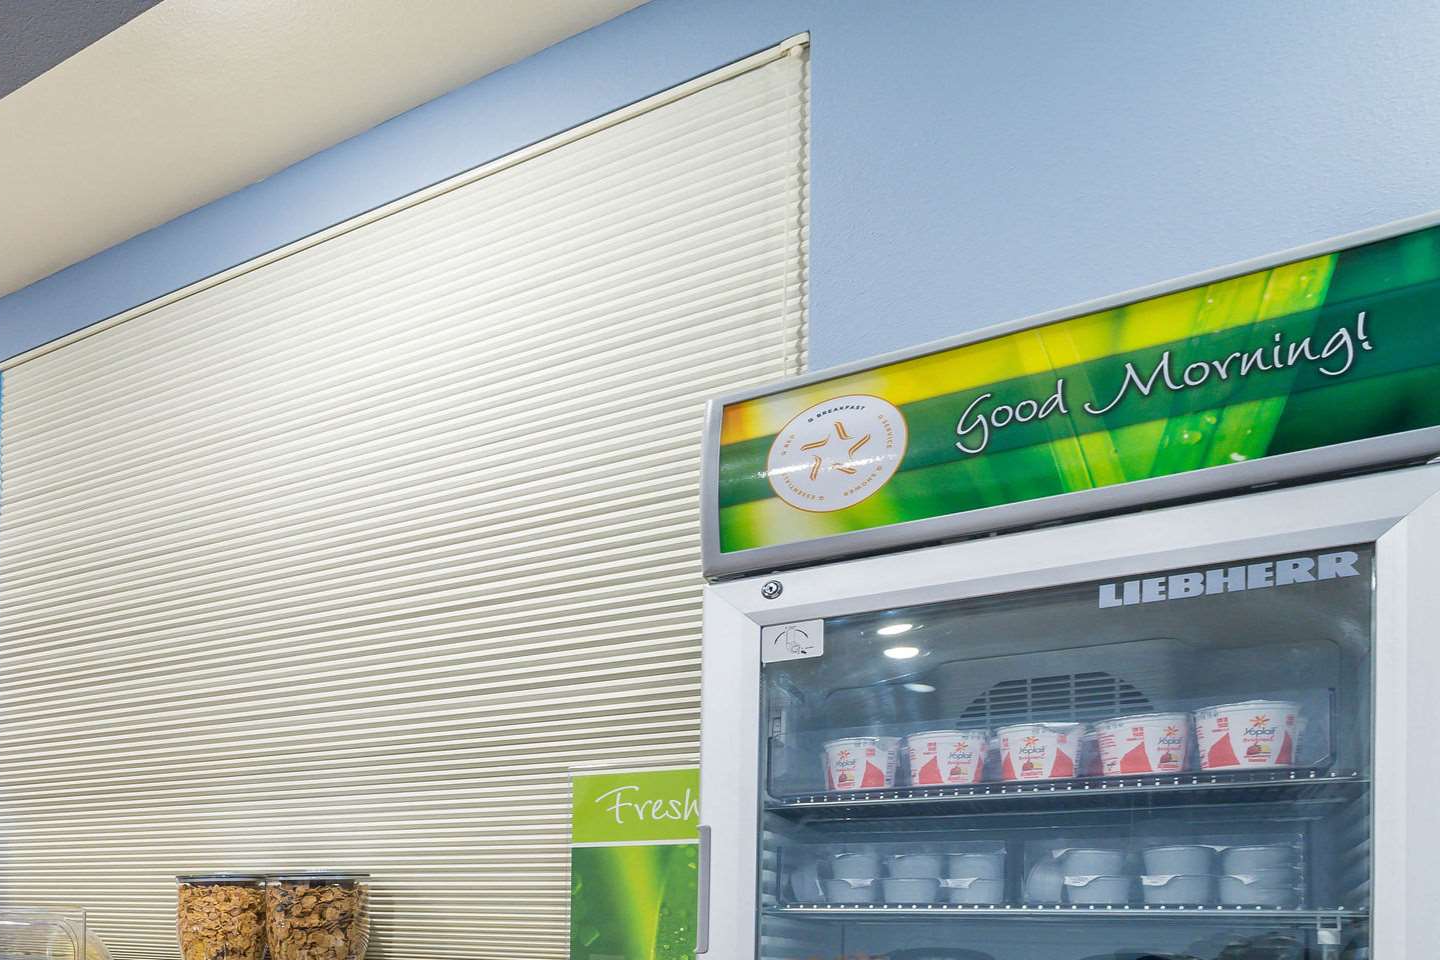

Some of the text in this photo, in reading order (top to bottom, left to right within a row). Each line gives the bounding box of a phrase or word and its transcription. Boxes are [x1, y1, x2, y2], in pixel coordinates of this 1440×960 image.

[954, 311, 1373, 454] Good Morning!
[1098, 551, 1361, 609] LIEBHERR
[595, 785, 700, 824] Fresh
